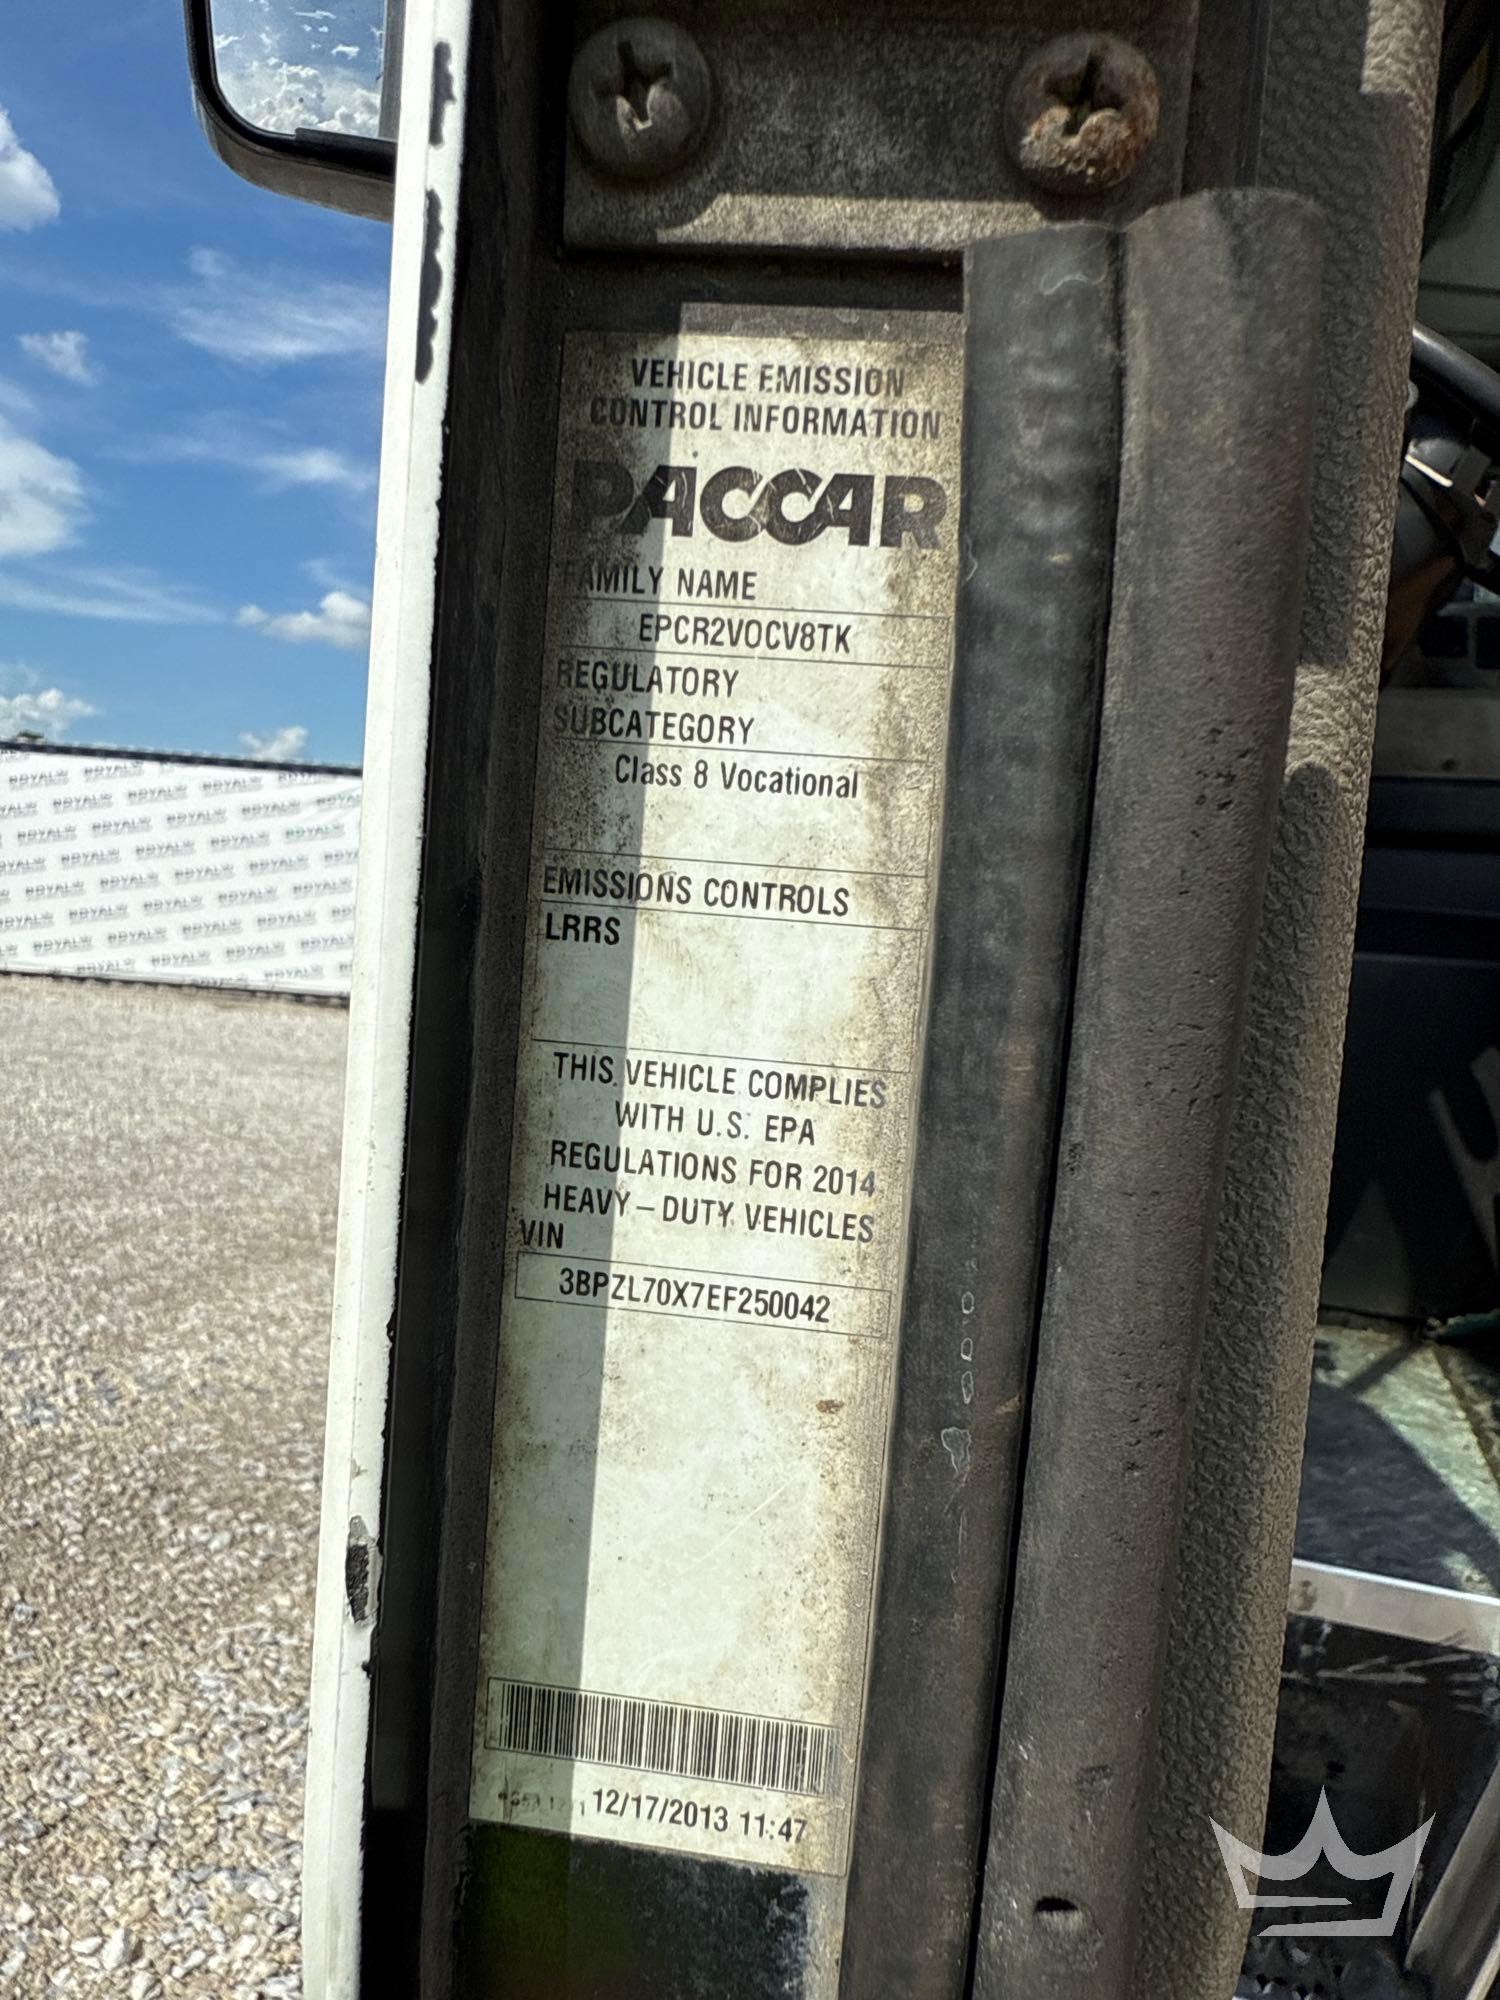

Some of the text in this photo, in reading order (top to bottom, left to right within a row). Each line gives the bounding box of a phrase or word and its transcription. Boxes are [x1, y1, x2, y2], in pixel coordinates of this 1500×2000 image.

[631, 359, 905, 396] VEHICLE EMISSION
[590, 399, 941, 440] CONTROL INFORMATION
[571, 462, 949, 549] PACCAR
[677, 568, 758, 600] NAME
[555, 659, 739, 698] REGULATORY
[552, 706, 755, 746] SUBCATEGORY
[614, 754, 859, 799] Class 8 Vocational
[542, 866, 850, 917] EMISSIONS CONTROLS
[545, 911, 621, 946] LRRS
[552, 1051, 888, 1109] THIS VEHICLE COMPLIES
[614, 1100, 815, 1146] WITH U.S. EPA
[549, 1139, 876, 1197] REGULATIONS FOR 2014
[519, 1218, 565, 1249] VIN
[745, 1202, 875, 1244] VEHICLES
[558, 1266, 831, 1324] 3BPZL70X7EF250042
[592, 1787, 729, 1833] 12/17/2013
[739, 1811, 808, 1844] 11:47
